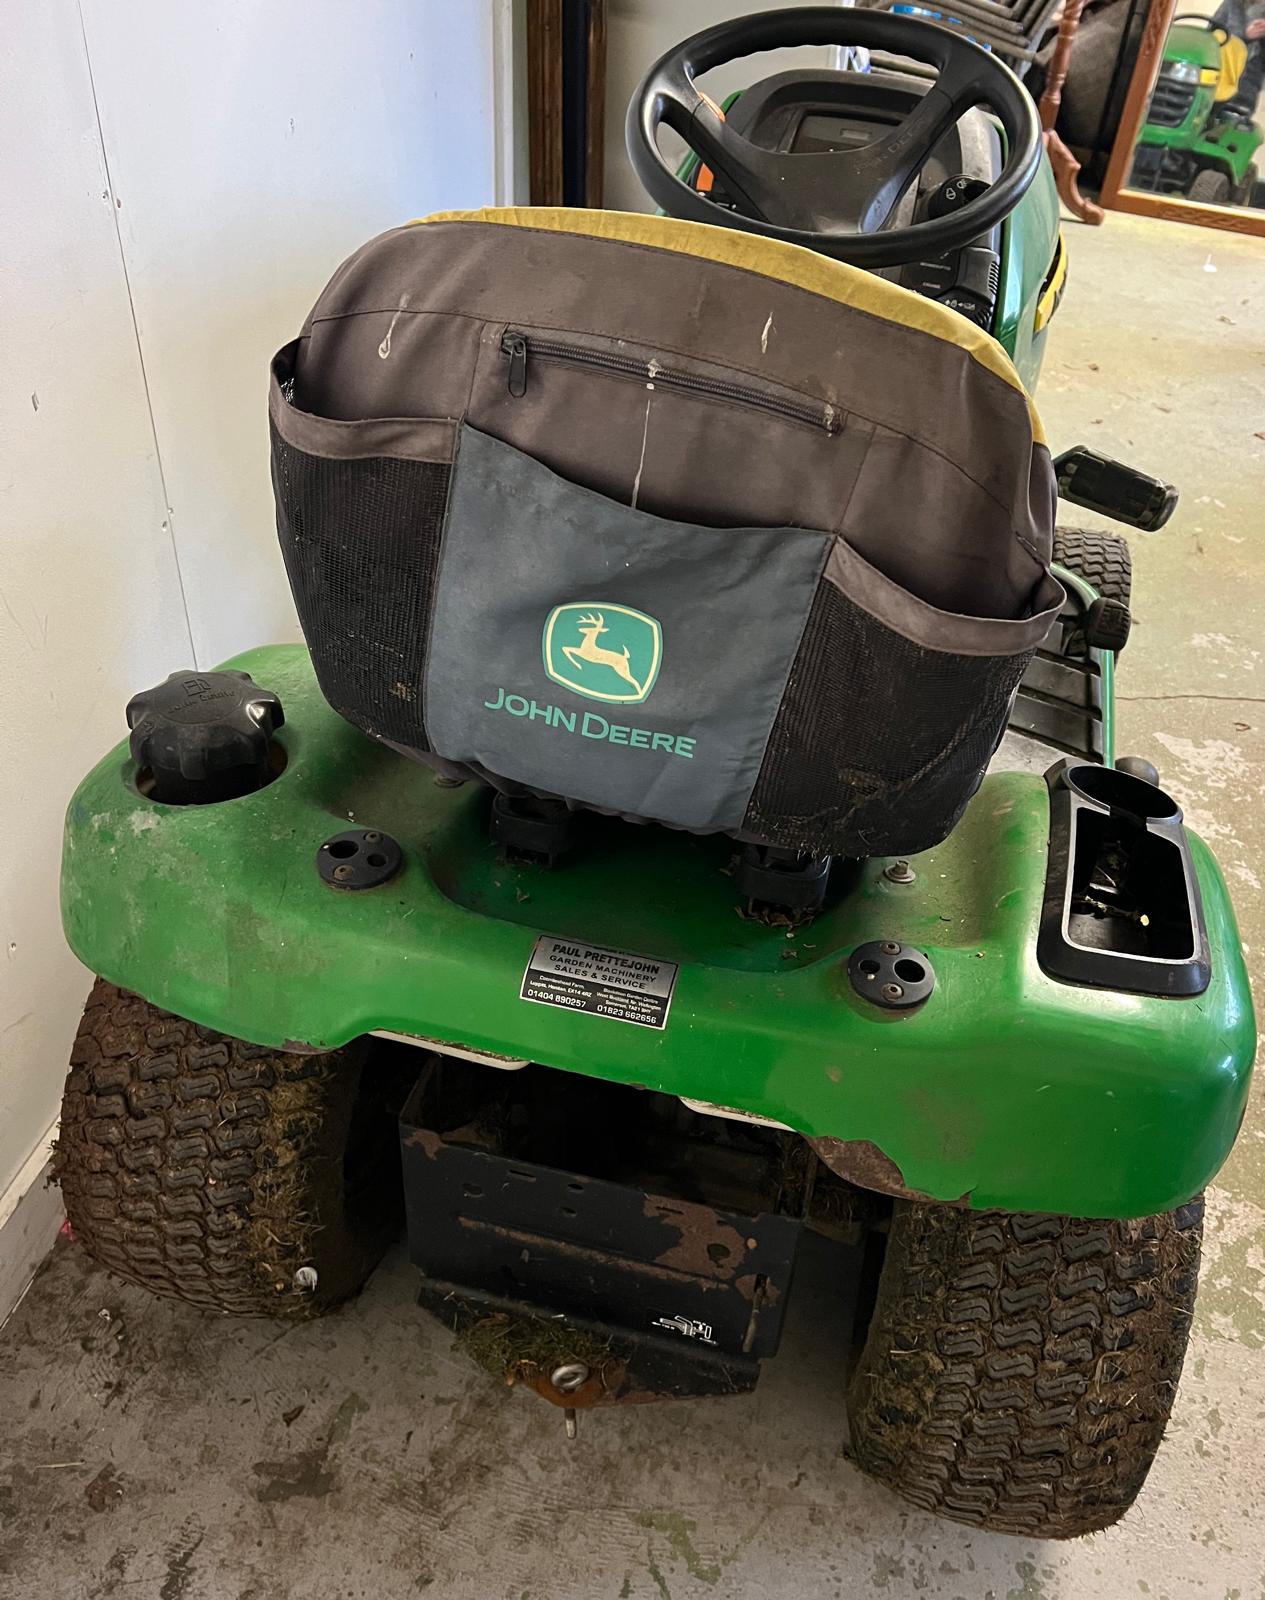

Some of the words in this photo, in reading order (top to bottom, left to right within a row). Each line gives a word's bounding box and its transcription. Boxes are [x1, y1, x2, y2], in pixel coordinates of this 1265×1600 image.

[484, 687, 577, 732] JOHN
[581, 711, 697, 759] DEERE
[549, 955, 593, 969] GARDEN
[595, 964, 657, 983] MACHINERY
[552, 944, 581, 958] PAUL
[583, 950, 660, 975] PRETTEJOHN
[554, 964, 588, 977] SALES
[601, 974, 647, 990] SERVICE
[527, 989, 554, 1001] 01404
[555, 994, 587, 1008] 890257
[625, 1011, 657, 1024] 662656
